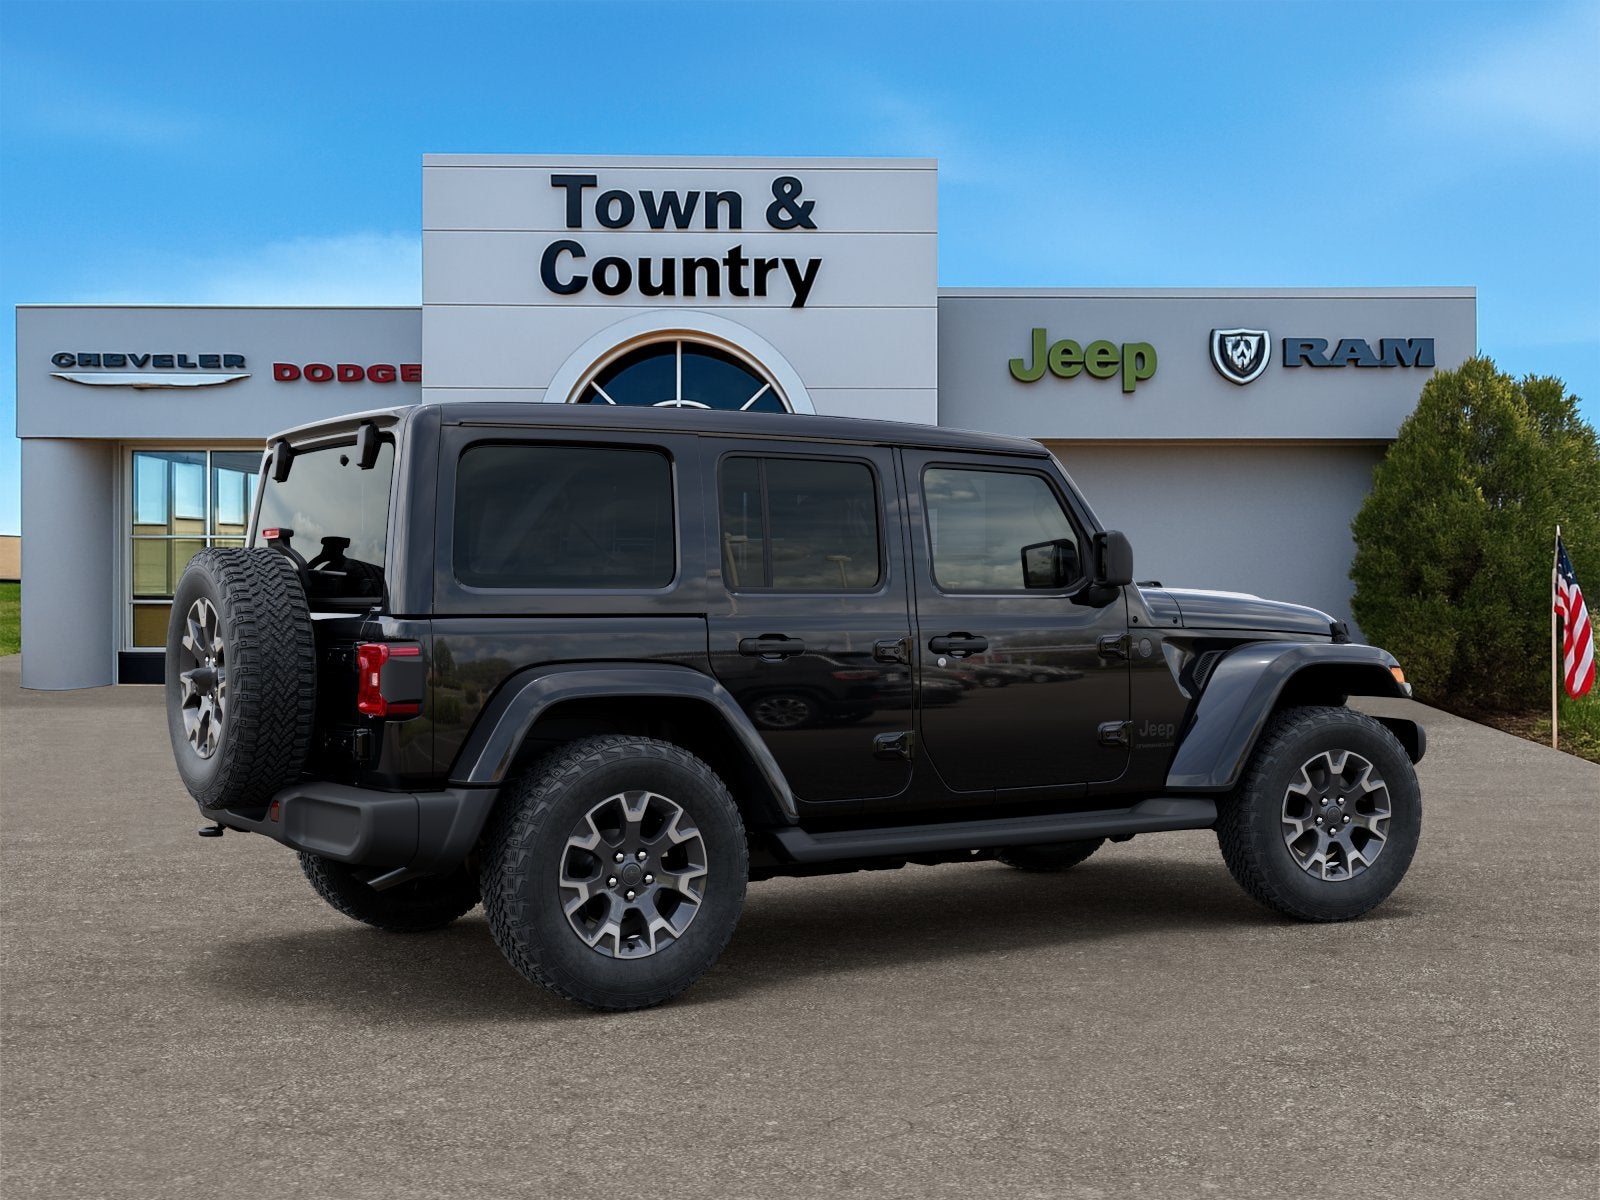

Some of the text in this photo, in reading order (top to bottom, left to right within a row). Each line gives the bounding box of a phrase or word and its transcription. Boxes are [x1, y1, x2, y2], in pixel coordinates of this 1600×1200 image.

[550, 174, 818, 229] Town &
[540, 239, 822, 308] Country
[273, 362, 422, 383] DODGE
[1008, 328, 1157, 393] Jeep
[1282, 337, 1435, 368] RAM
[1139, 720, 1176, 739] Jeep
